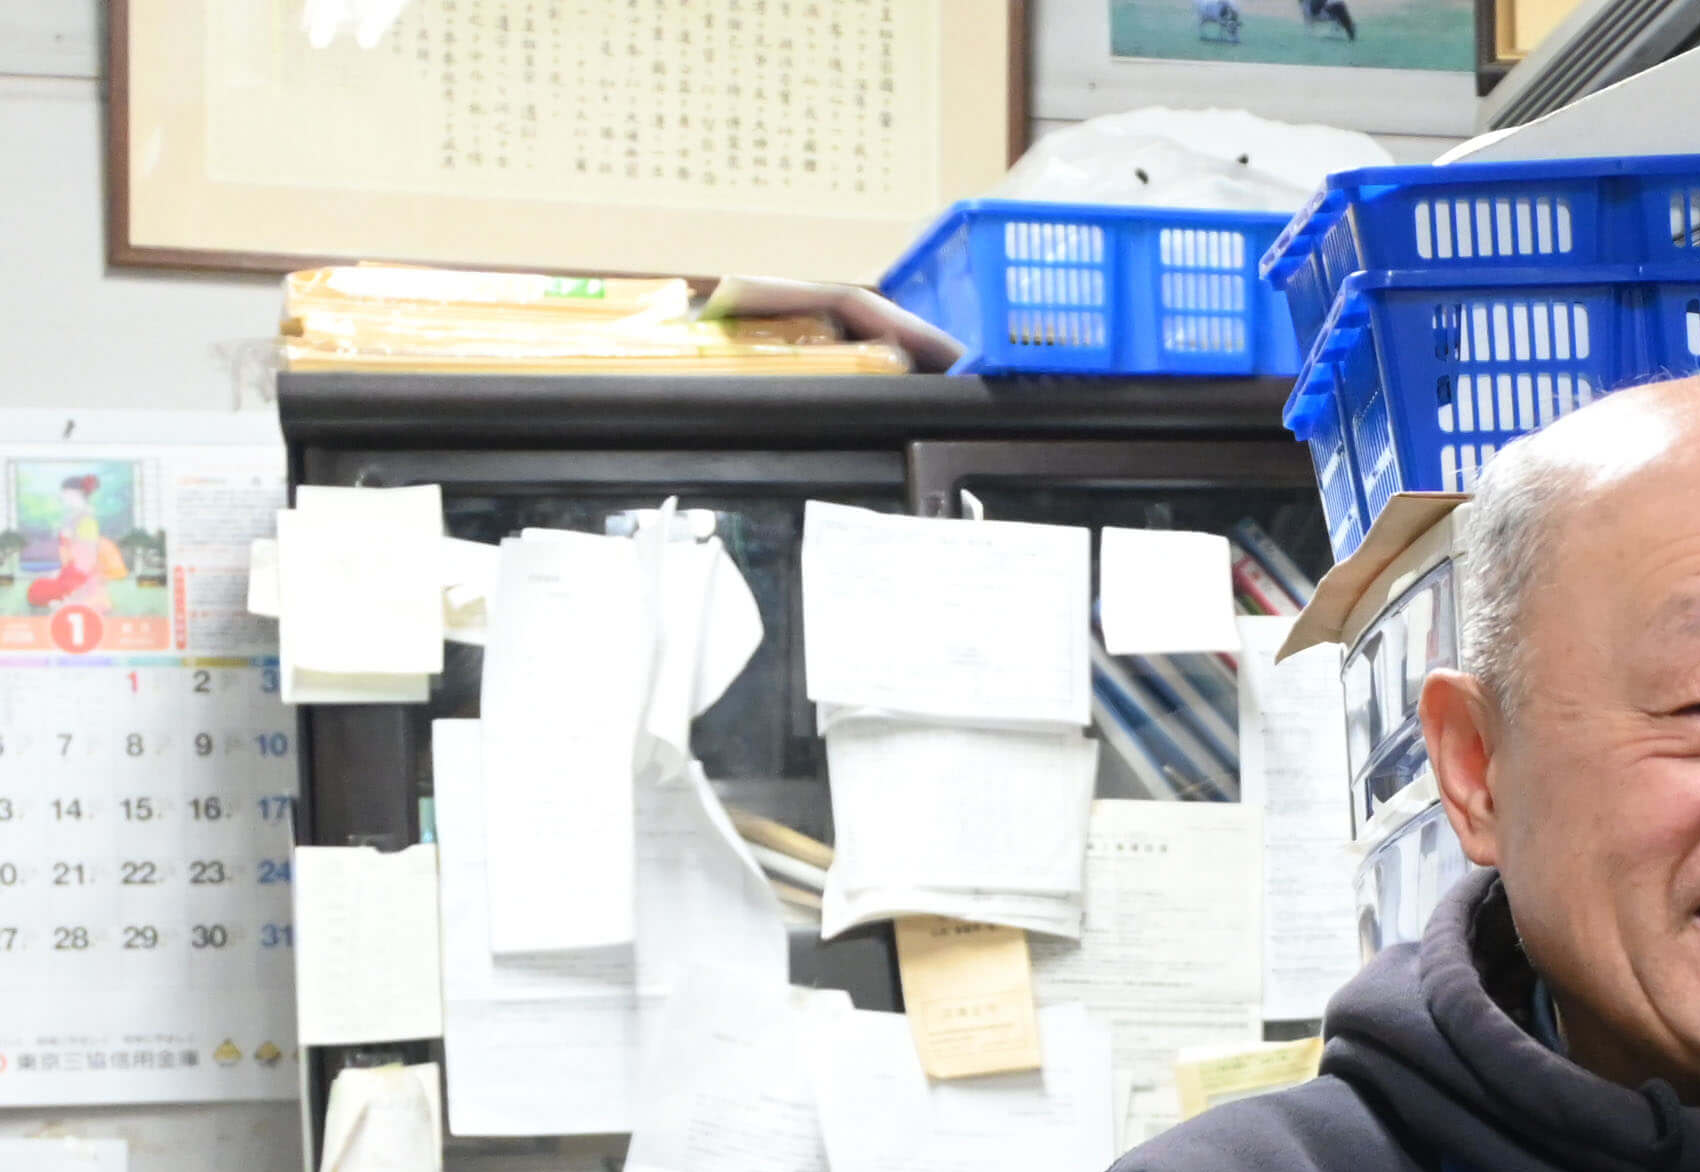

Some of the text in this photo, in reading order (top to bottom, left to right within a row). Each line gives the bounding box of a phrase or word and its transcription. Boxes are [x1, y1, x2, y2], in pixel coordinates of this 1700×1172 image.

[67, 612, 85, 647] 1
[128, 670, 280, 692] 1 2 3
[56, 732, 288, 756] 7 8 9 10
[0, 796, 290, 821] 3 14 15 16 17
[0, 860, 292, 886] 0 21 22 23 24
[0, 924, 294, 950] 7 28 29 30 31
